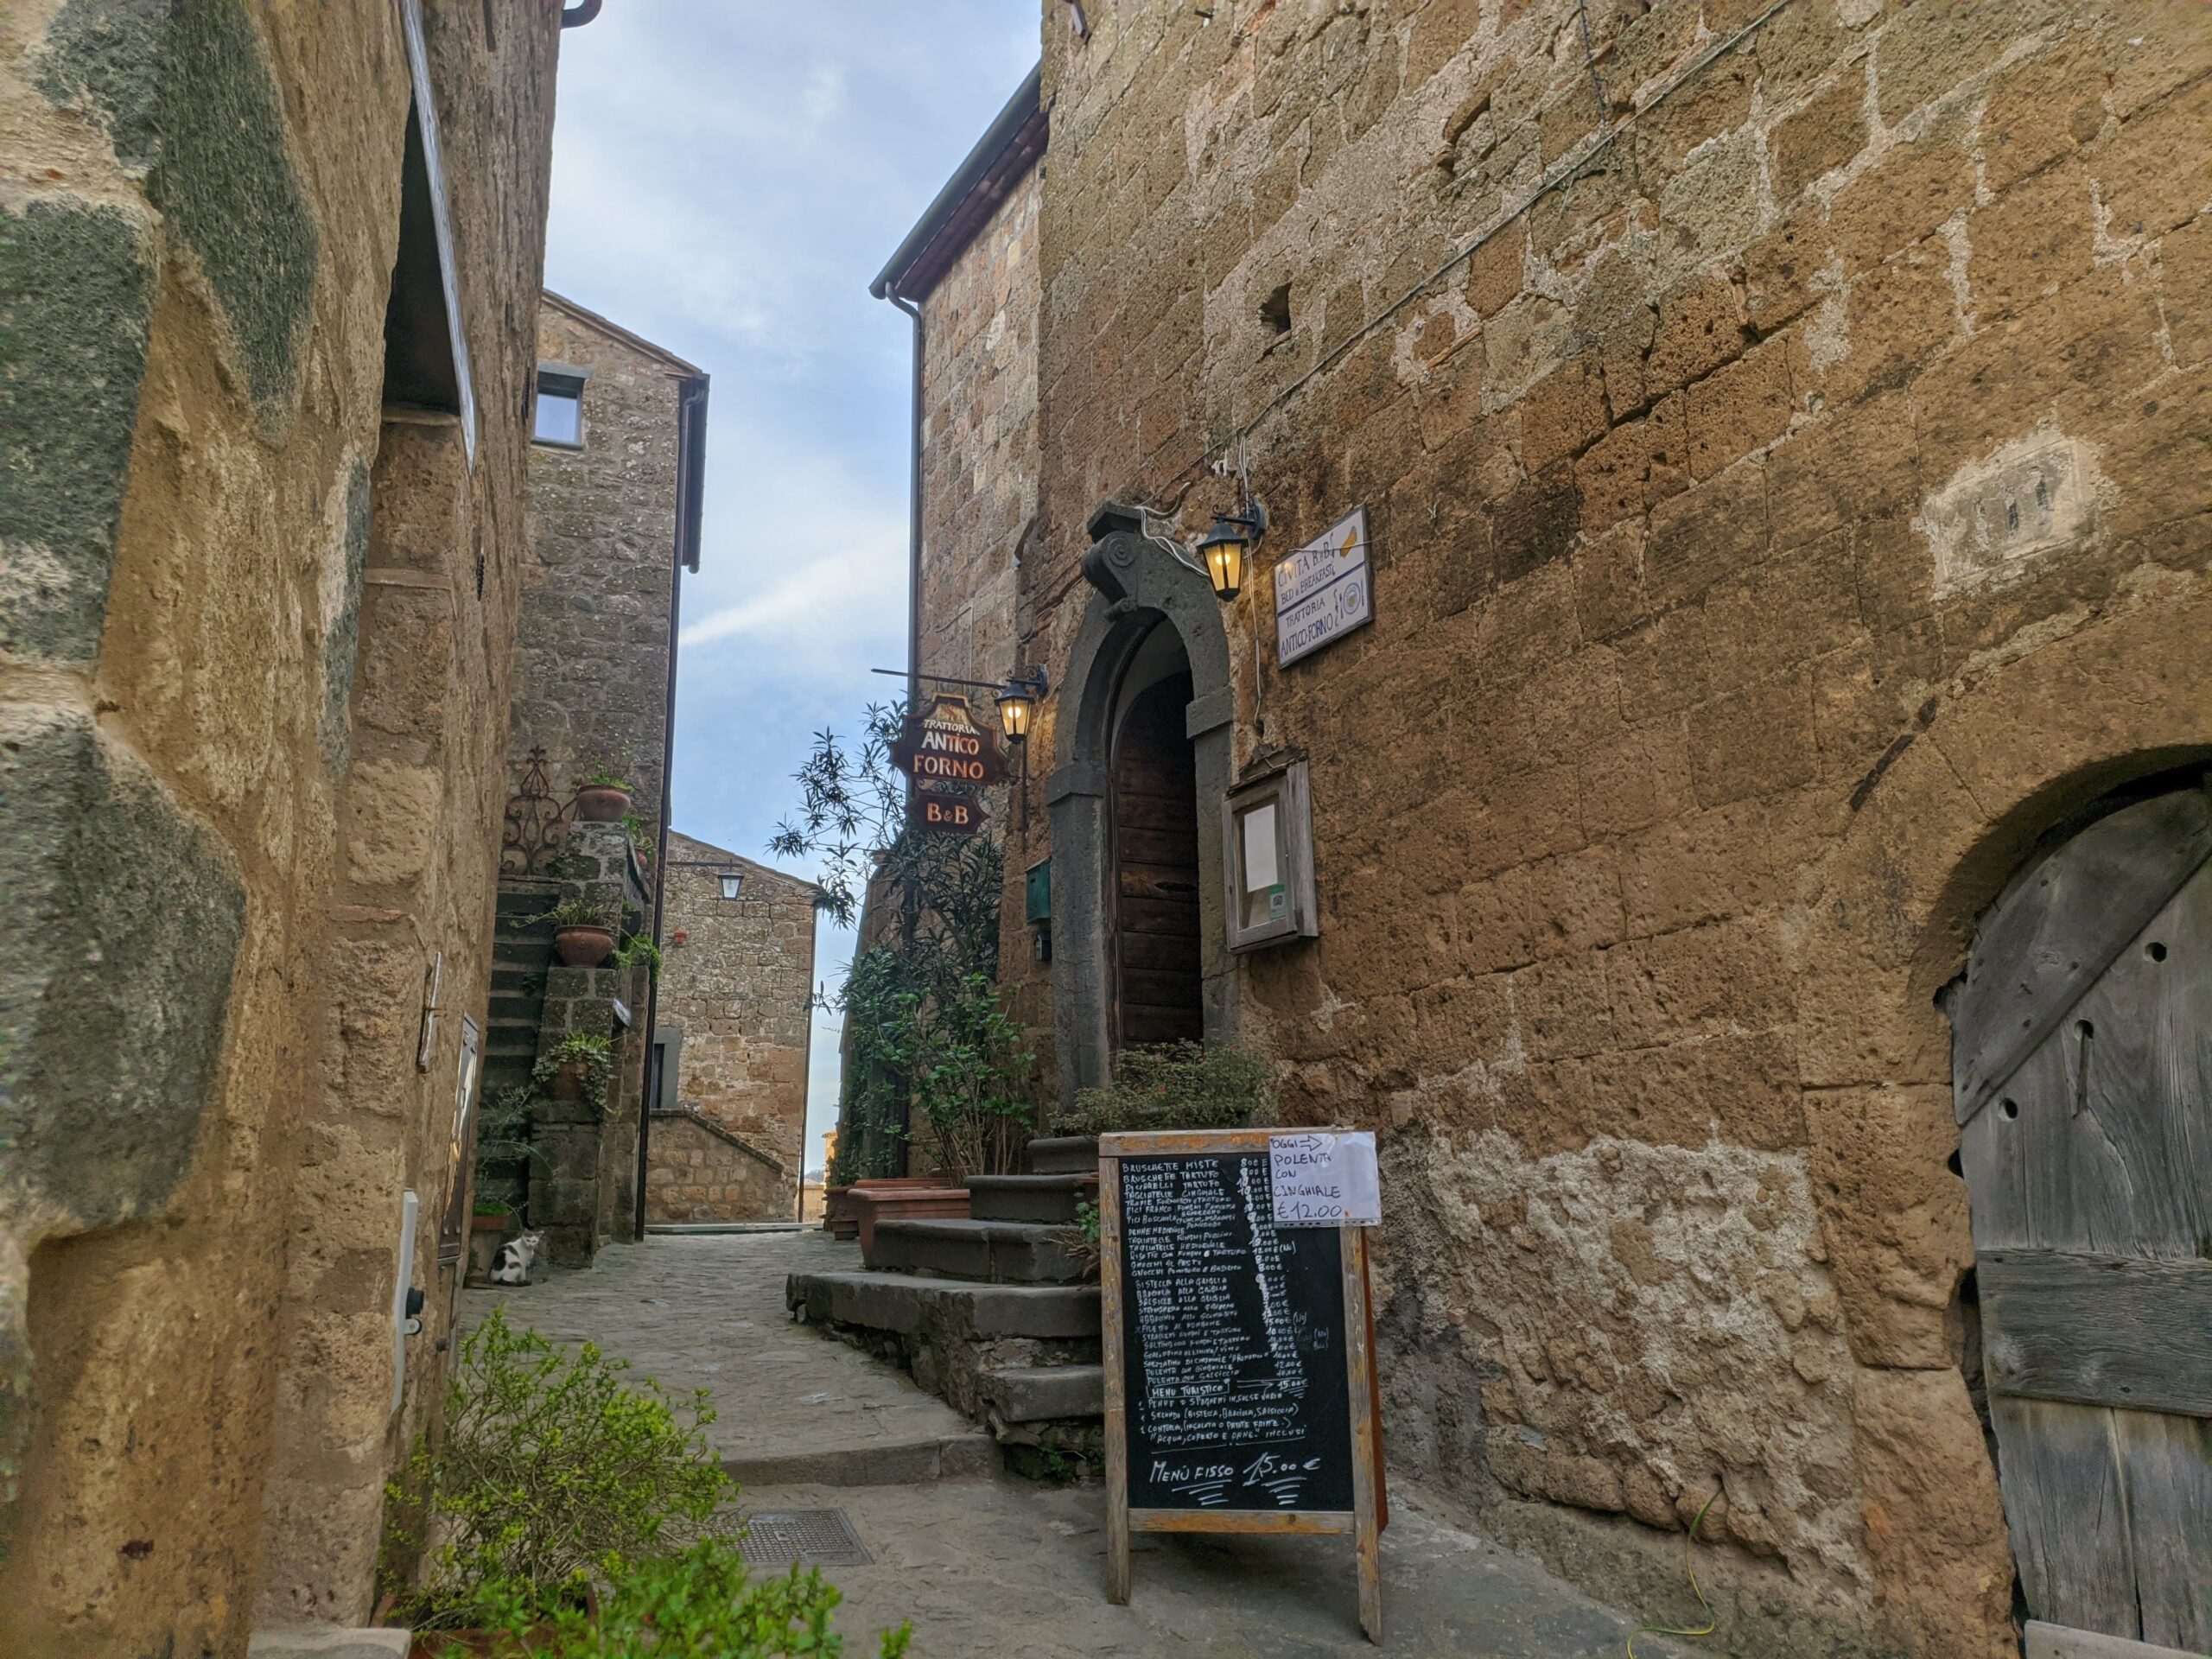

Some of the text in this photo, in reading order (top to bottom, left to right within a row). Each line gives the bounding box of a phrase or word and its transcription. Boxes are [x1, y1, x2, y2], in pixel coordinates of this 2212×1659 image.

[1278, 556, 1310, 588] CIVITA
[1281, 590, 1294, 605] BED
[1286, 597, 1325, 628] TRATTORIA
[923, 719, 981, 735] TRATTORIA
[921, 731, 980, 756] ANTICO
[913, 753, 984, 779] FORNO
[1270, 1138, 1298, 1148] OGGI
[1274, 1153, 1332, 1166] POLENTA
[1179, 1171, 1219, 1179] TARTUFO
[1275, 1169, 1296, 1179] CON
[1184, 1180, 1220, 1189] TARTUFO
[1274, 1185, 1341, 1198] CINGHIALE
[1152, 1387, 1176, 1397] MENU
[1194, 1465, 1234, 1479] FISSO
[1303, 1458, 1321, 1471] €
